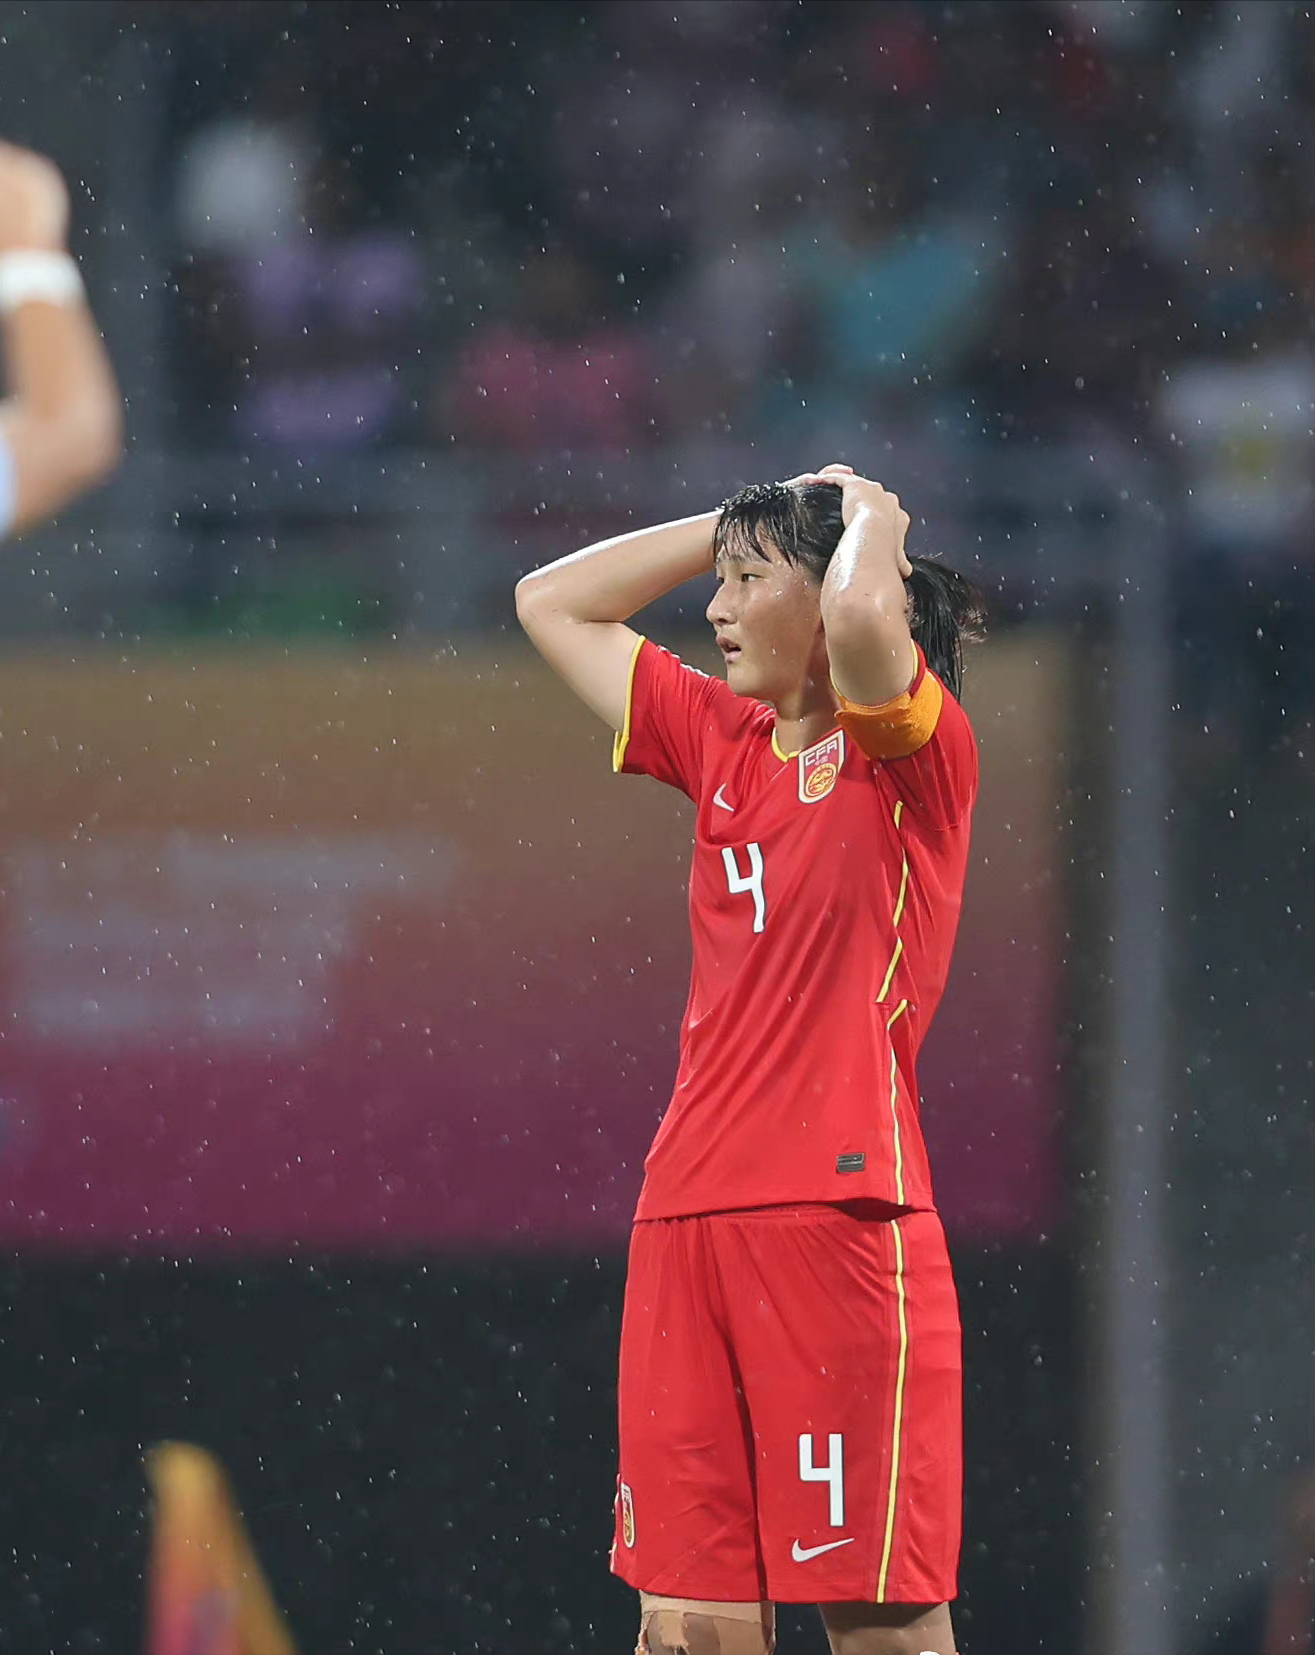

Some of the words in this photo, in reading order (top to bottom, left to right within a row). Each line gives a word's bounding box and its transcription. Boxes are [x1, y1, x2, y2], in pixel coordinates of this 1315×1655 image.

[805, 739, 837, 766] CFA
[722, 842, 765, 933] 4
[799, 1433, 844, 1526] 4
